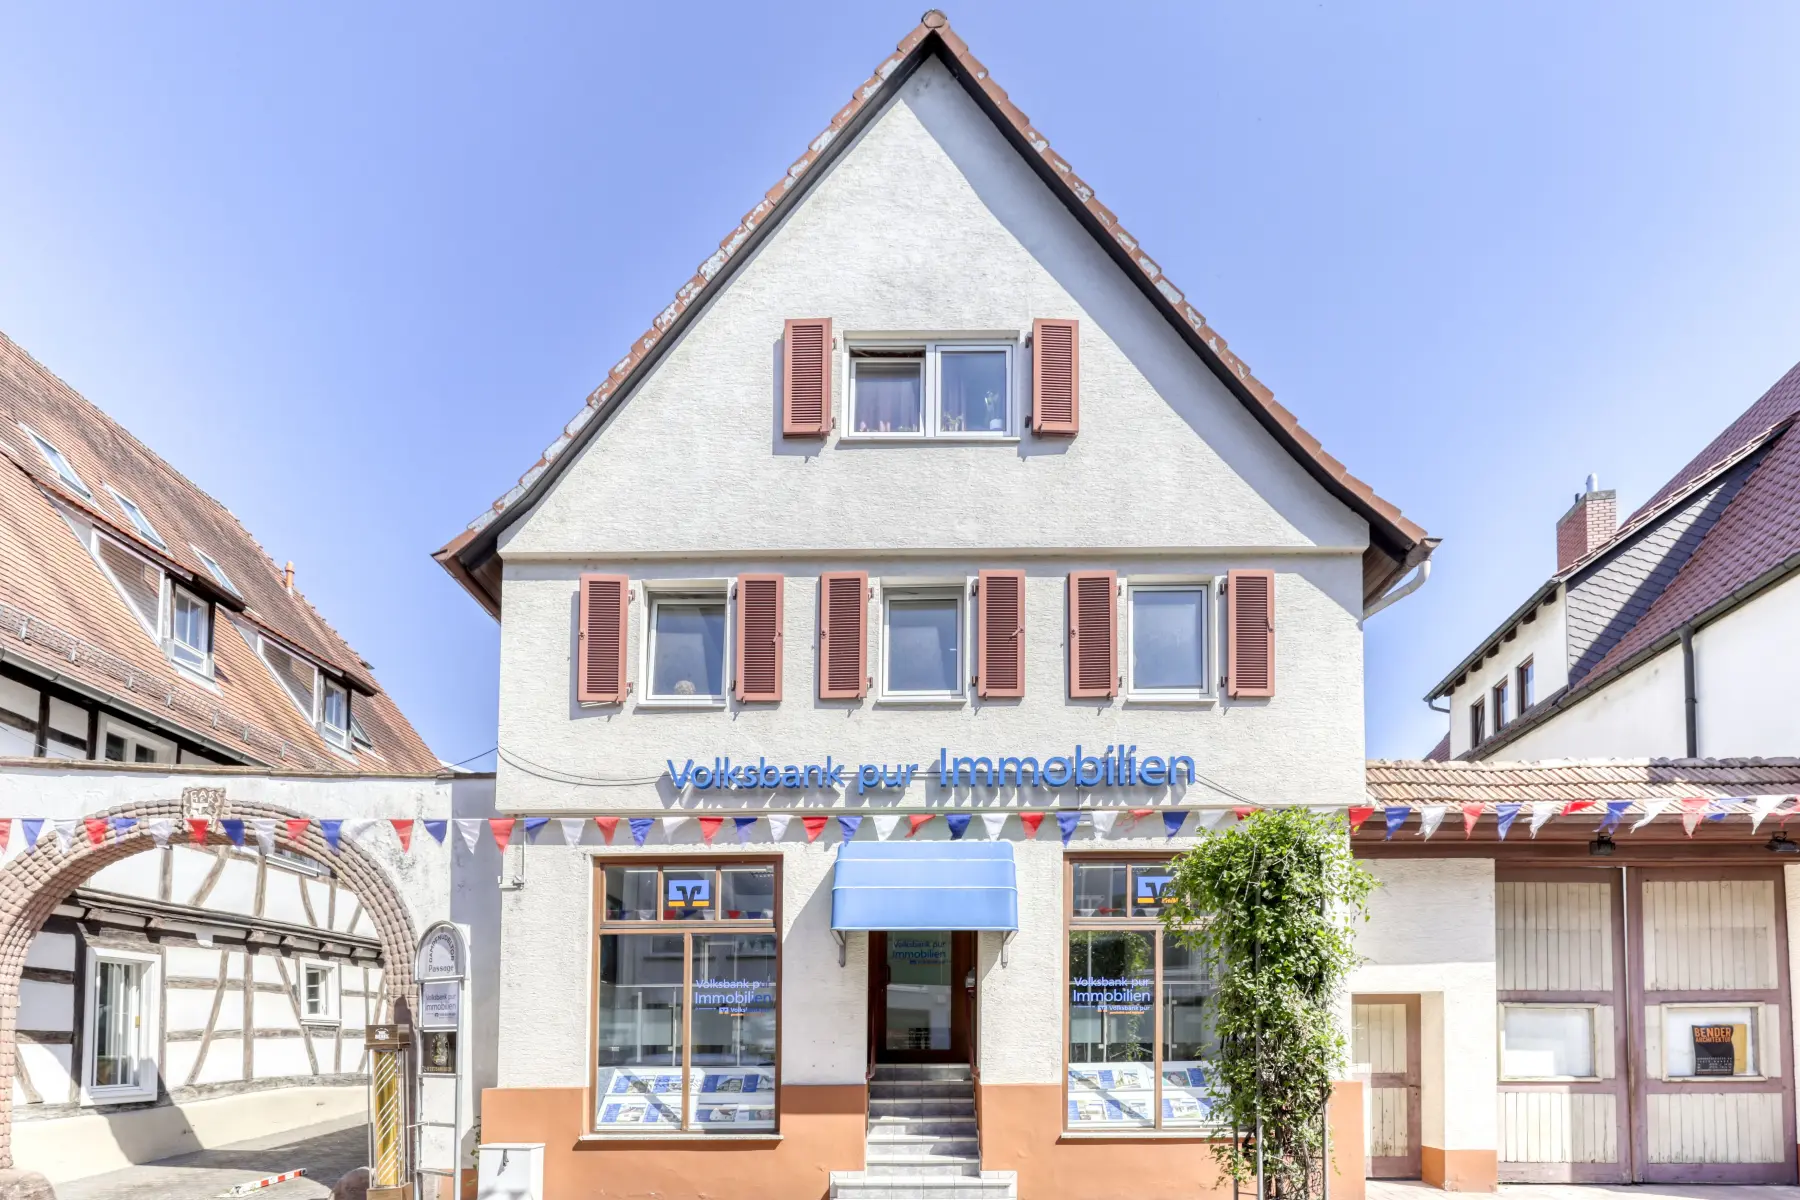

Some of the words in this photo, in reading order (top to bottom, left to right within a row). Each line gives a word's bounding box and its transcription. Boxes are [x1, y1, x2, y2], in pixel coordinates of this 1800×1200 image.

[667, 756, 845, 790] Volksbank
[859, 763, 918, 795] pur
[940, 744, 1196, 788] Immobilien
[893, 949, 946, 959] Immobilien
[695, 979, 750, 989] Volksbank
[1073, 976, 1128, 987] Volksbank
[1132, 978, 1150, 988] pur
[695, 991, 773, 1004] Immobilien
[1073, 988, 1151, 1002] Immobilien
[1694, 1027, 1731, 1037] BENDER
